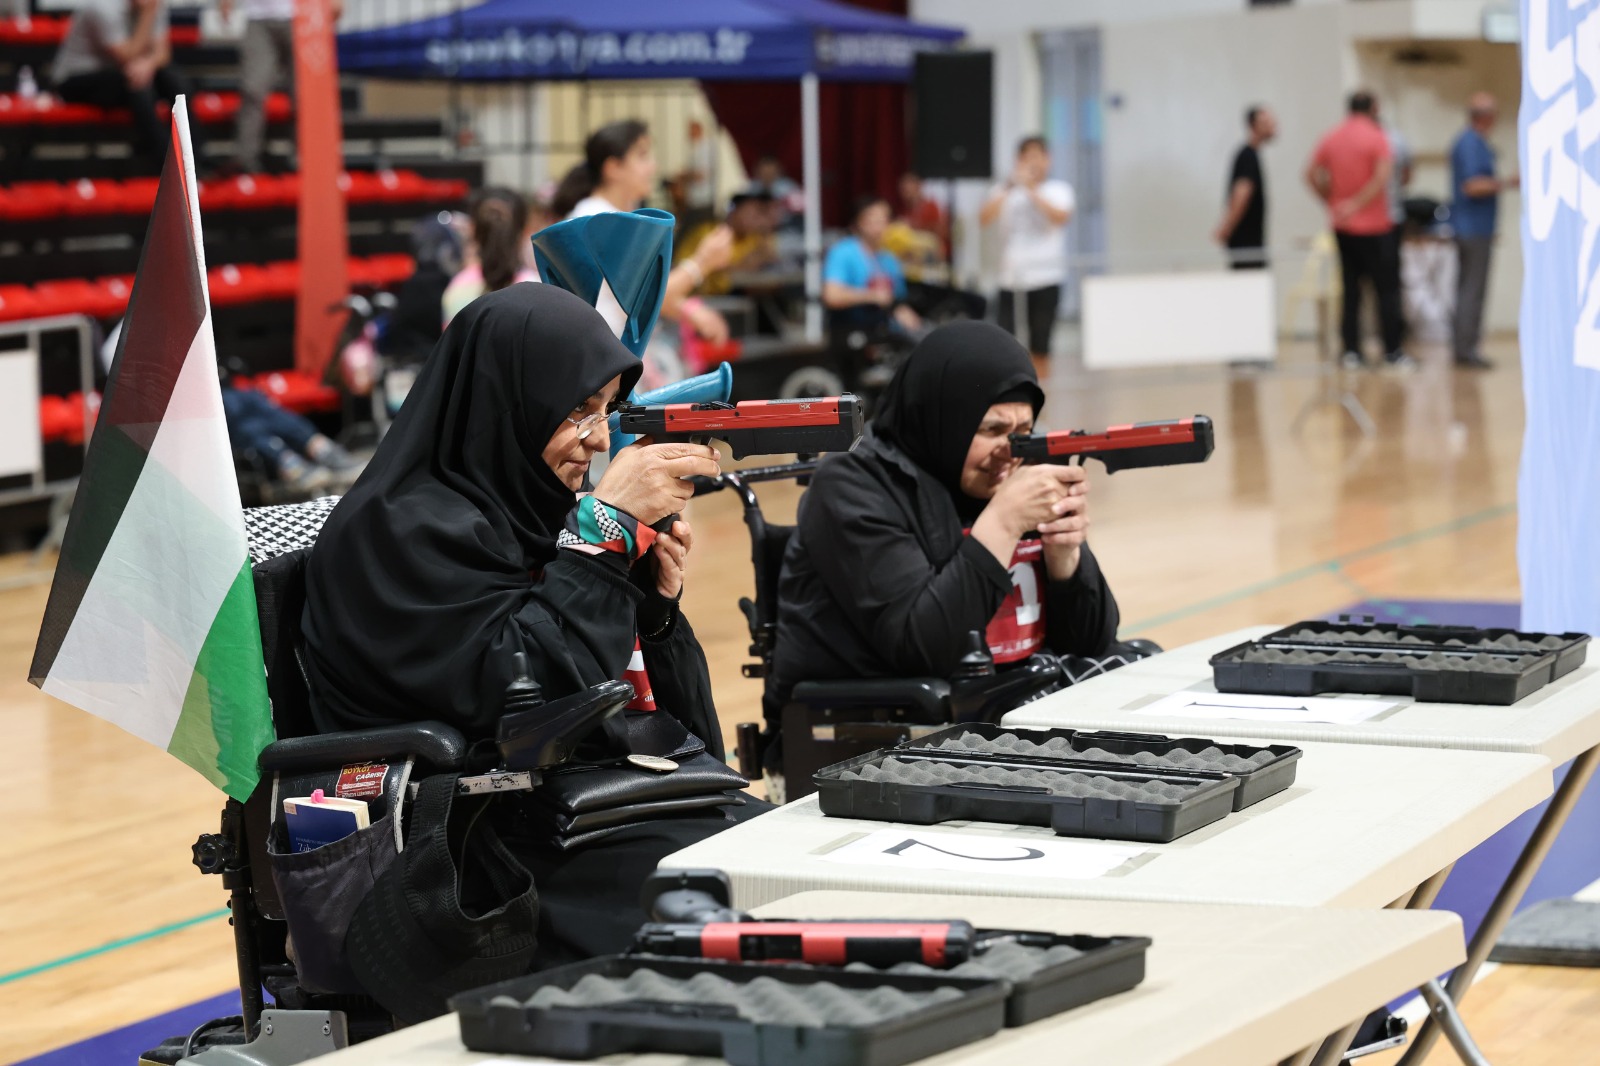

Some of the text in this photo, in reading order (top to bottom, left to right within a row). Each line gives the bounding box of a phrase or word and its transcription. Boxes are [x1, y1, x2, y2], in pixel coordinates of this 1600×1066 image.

[1008, 561, 1042, 626] 1
[343, 766, 371, 775] BOYKOT
[881, 838, 1045, 861] 2
